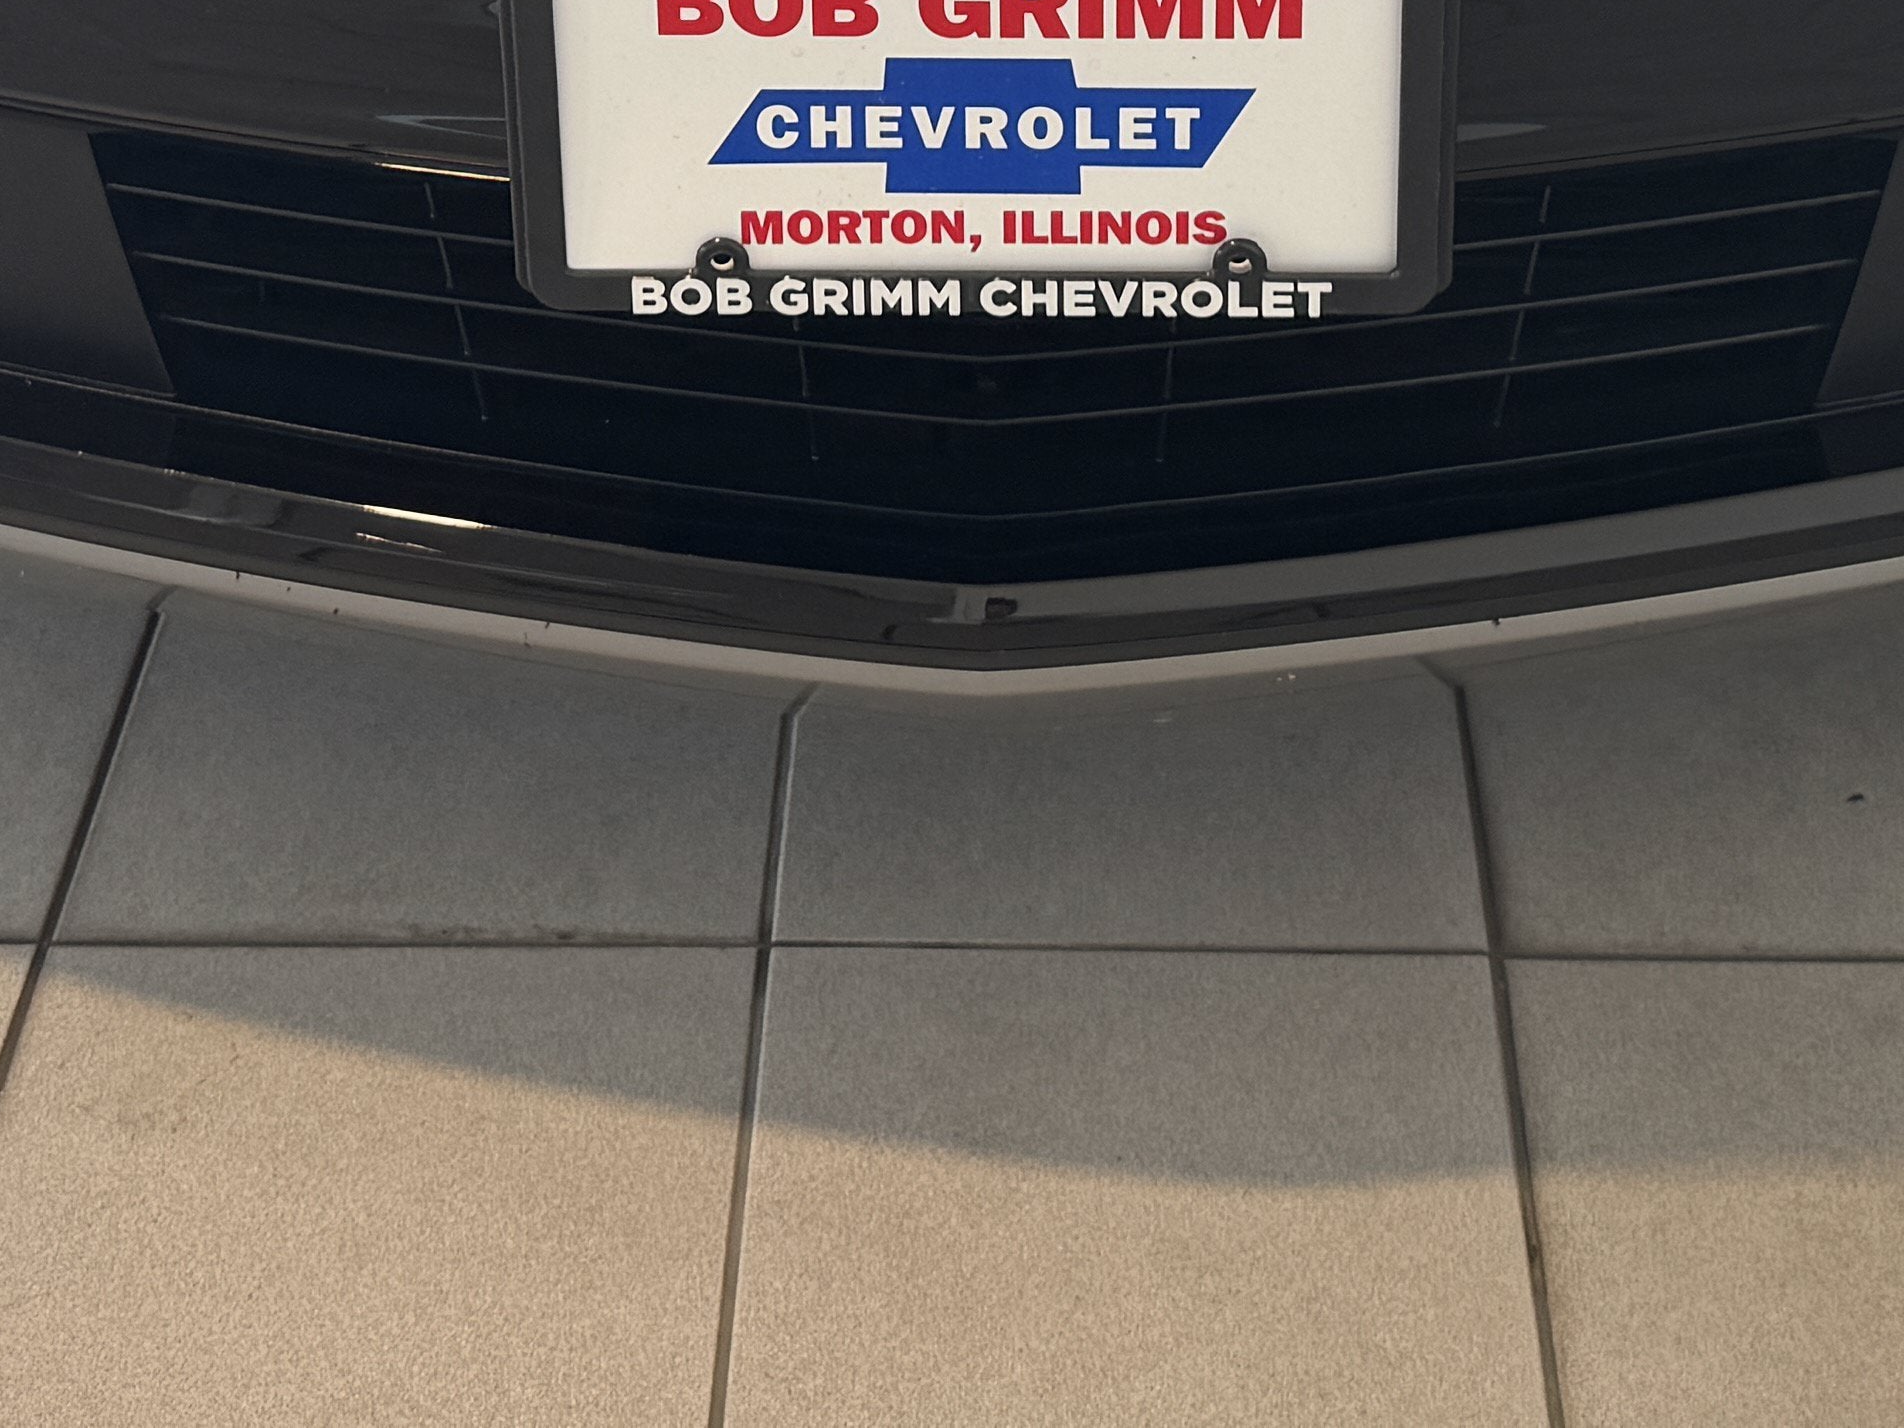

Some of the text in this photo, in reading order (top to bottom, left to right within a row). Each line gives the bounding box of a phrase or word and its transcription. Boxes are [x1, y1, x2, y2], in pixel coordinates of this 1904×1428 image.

[755, 105, 1201, 151] CHEVROLET
[740, 210, 1228, 252] MORTON, ILLINOIS
[631, 275, 1333, 319] BOB GRIMM CHEVROLET
